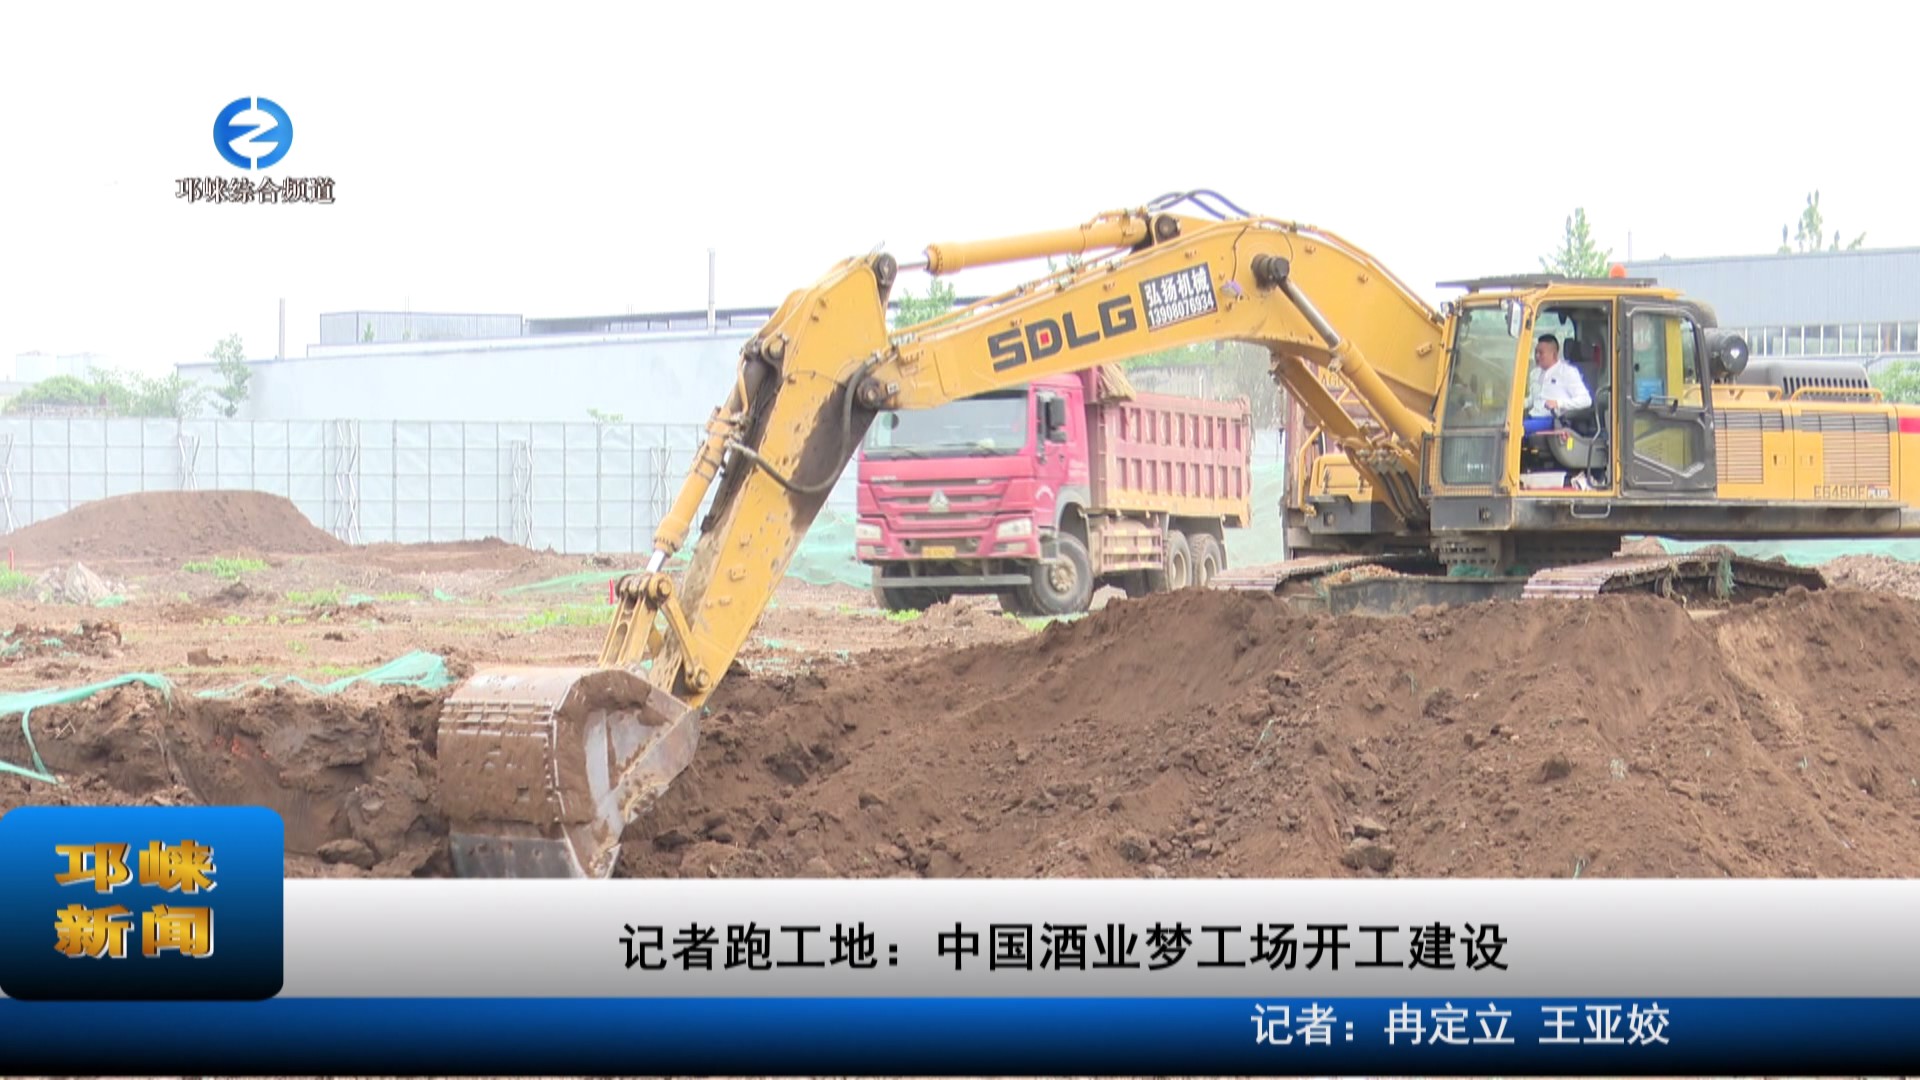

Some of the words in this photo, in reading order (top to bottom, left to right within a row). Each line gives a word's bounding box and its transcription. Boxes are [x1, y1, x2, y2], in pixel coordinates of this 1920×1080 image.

[1144, 266, 1210, 307] 弘扬机械
[1148, 291, 1214, 327] 13908076934
[987, 295, 1137, 373] SDLG
